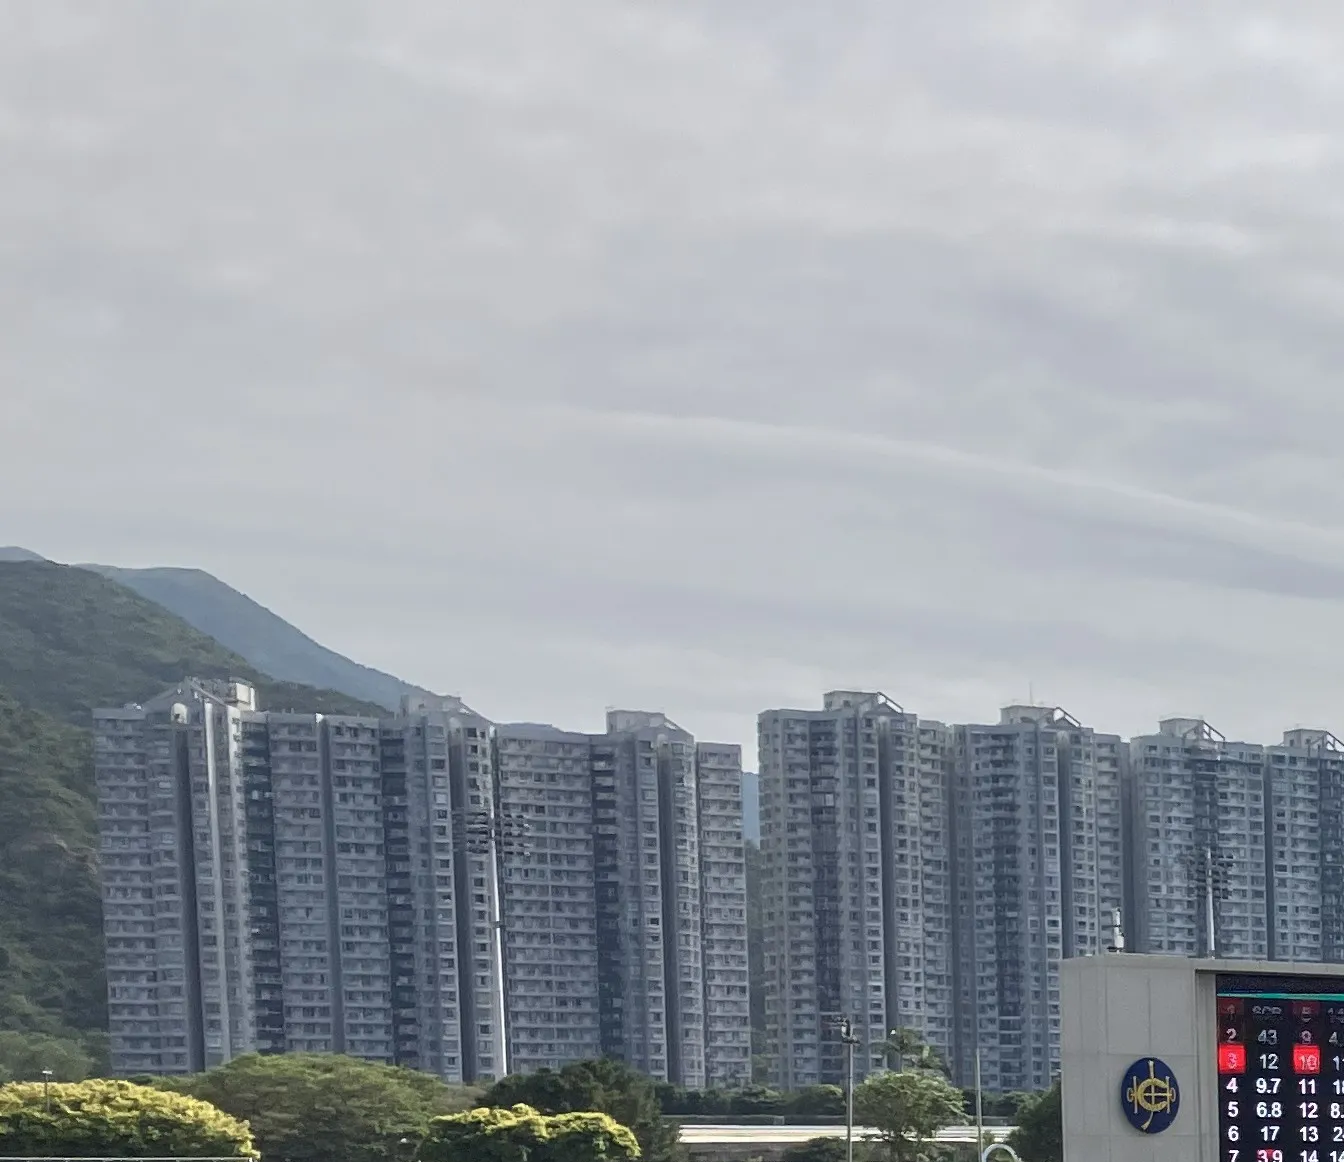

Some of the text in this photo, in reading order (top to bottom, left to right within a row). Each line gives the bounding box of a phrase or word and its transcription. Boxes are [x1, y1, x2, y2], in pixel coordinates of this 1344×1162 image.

[1226, 1028, 1237, 1043] 2
[1257, 1029, 1278, 1045] 43
[1227, 1052, 1237, 1069] 3
[1259, 1053, 1279, 1070] 12
[1226, 1078, 1238, 1093] 4
[1256, 1078, 1281, 1093] 9.7
[1299, 1079, 1315, 1094] 11
[1228, 1102, 1238, 1117] 5
[1257, 1102, 1282, 1117] 6.8
[1300, 1102, 1318, 1118] 12
[1228, 1126, 1239, 1141] 6
[1261, 1126, 1279, 1141] 17
[1300, 1126, 1318, 1142] 13
